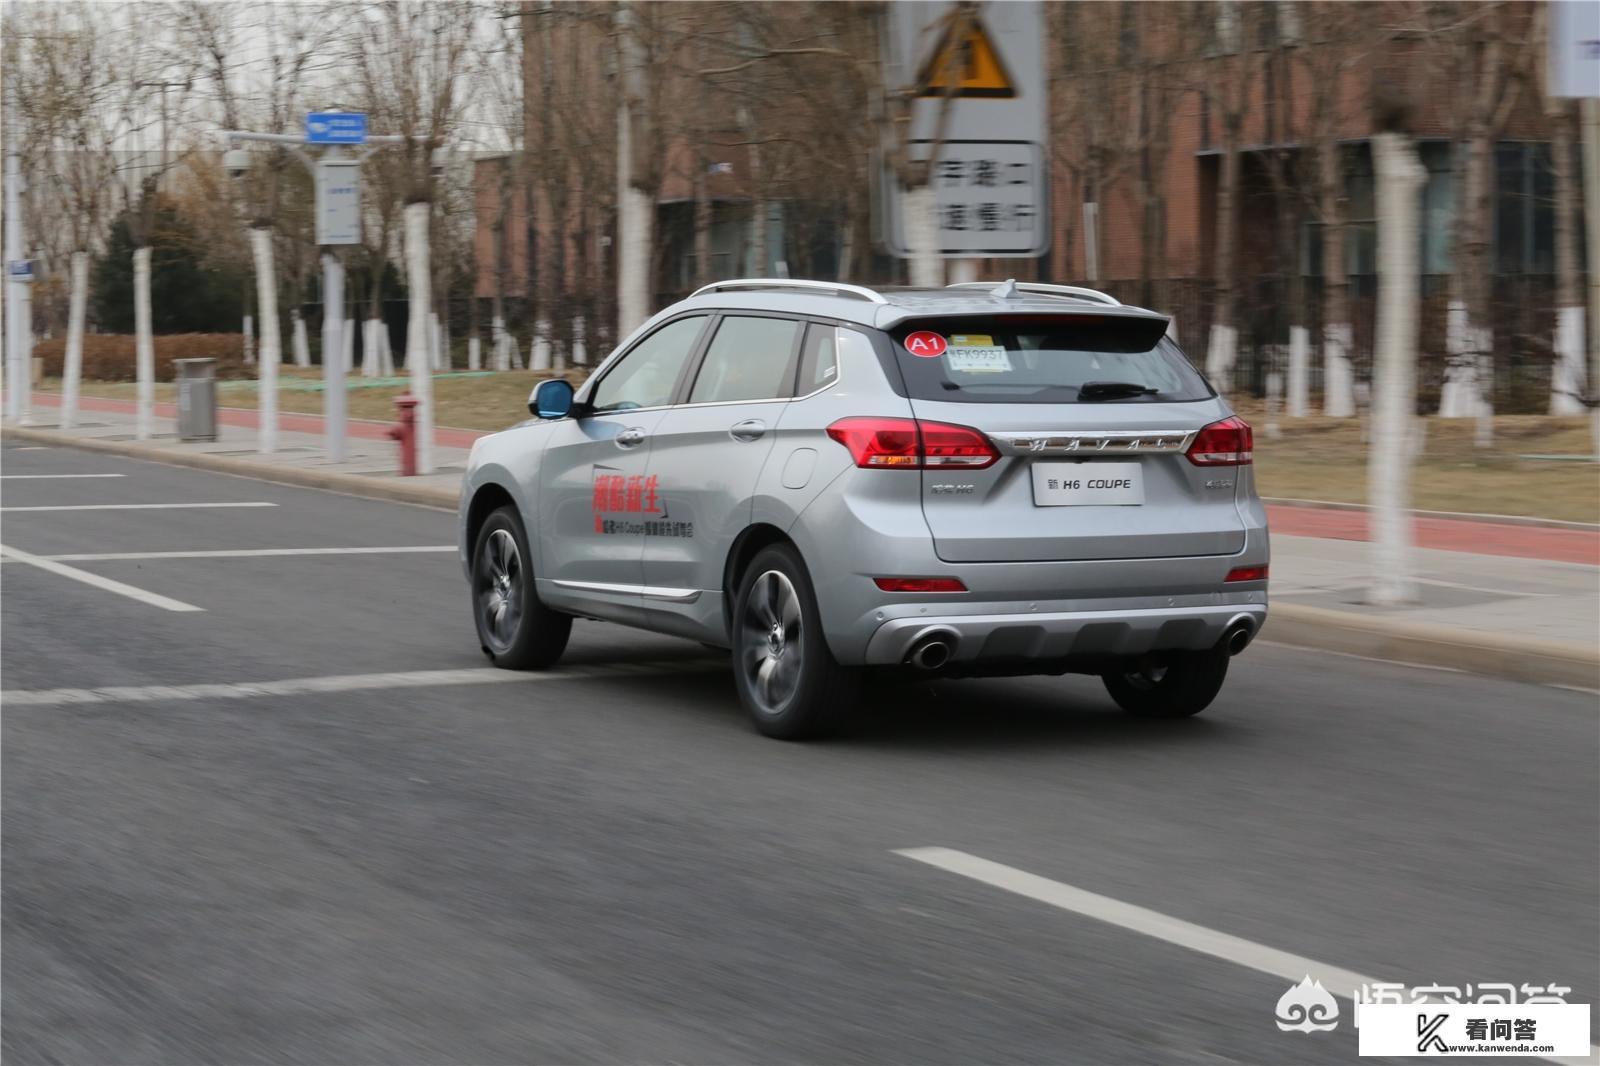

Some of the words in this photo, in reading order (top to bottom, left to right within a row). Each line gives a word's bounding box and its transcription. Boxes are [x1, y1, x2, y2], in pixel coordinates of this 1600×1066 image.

[911, 337, 939, 351] A1
[1063, 480, 1080, 490] H6
[1087, 479, 1131, 489] COUPE
